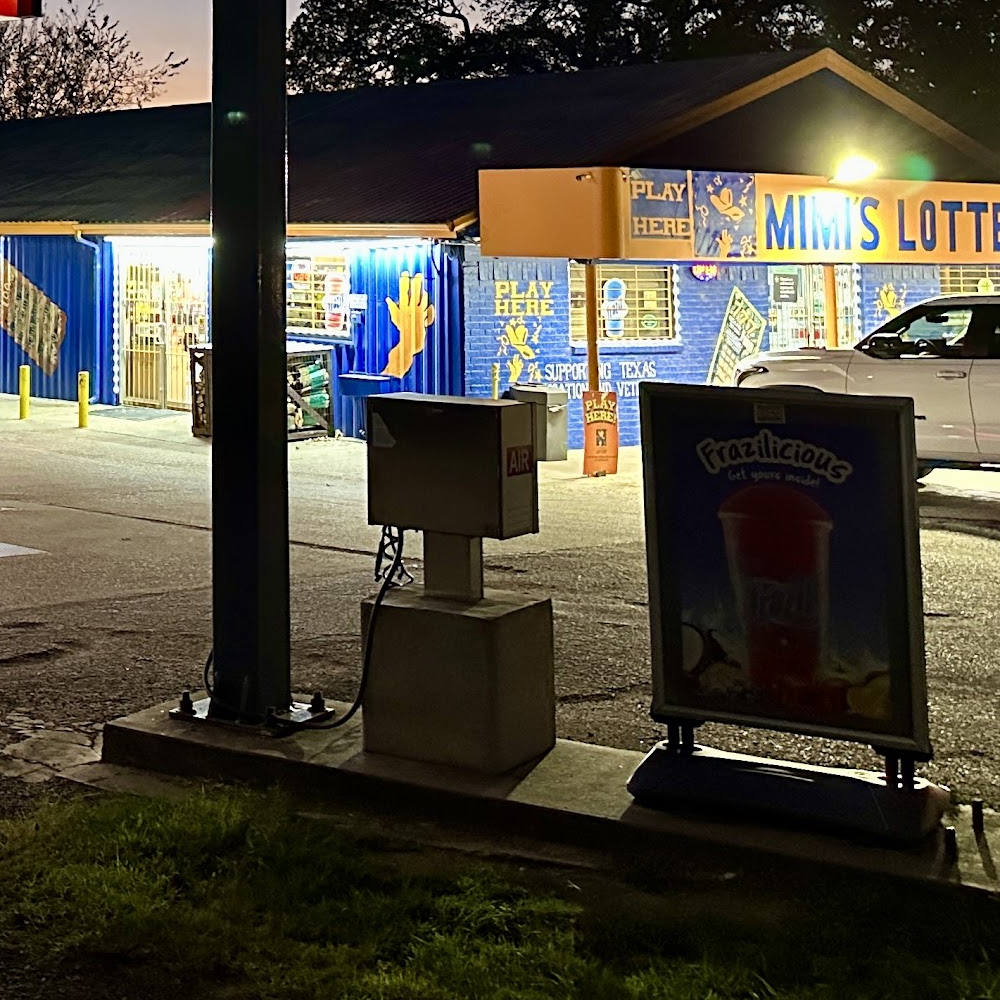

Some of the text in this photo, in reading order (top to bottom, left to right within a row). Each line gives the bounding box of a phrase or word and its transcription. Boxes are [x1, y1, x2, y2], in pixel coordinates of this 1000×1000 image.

[631, 180, 686, 202] PLAY
[633, 217, 691, 235] HERE
[764, 193, 880, 251] MIMI'S
[494, 281, 554, 299] PLAY
[494, 299, 554, 316] HERE
[544, 361, 657, 381] SUPPORNG TEXAS
[584, 400, 616, 410] PLAY
[585, 410, 617, 424] HERE!
[509, 450, 530, 475] AIR
[697, 428, 853, 484] Frazilicious
[727, 468, 747, 481] Get
[751, 471, 780, 482] yours
